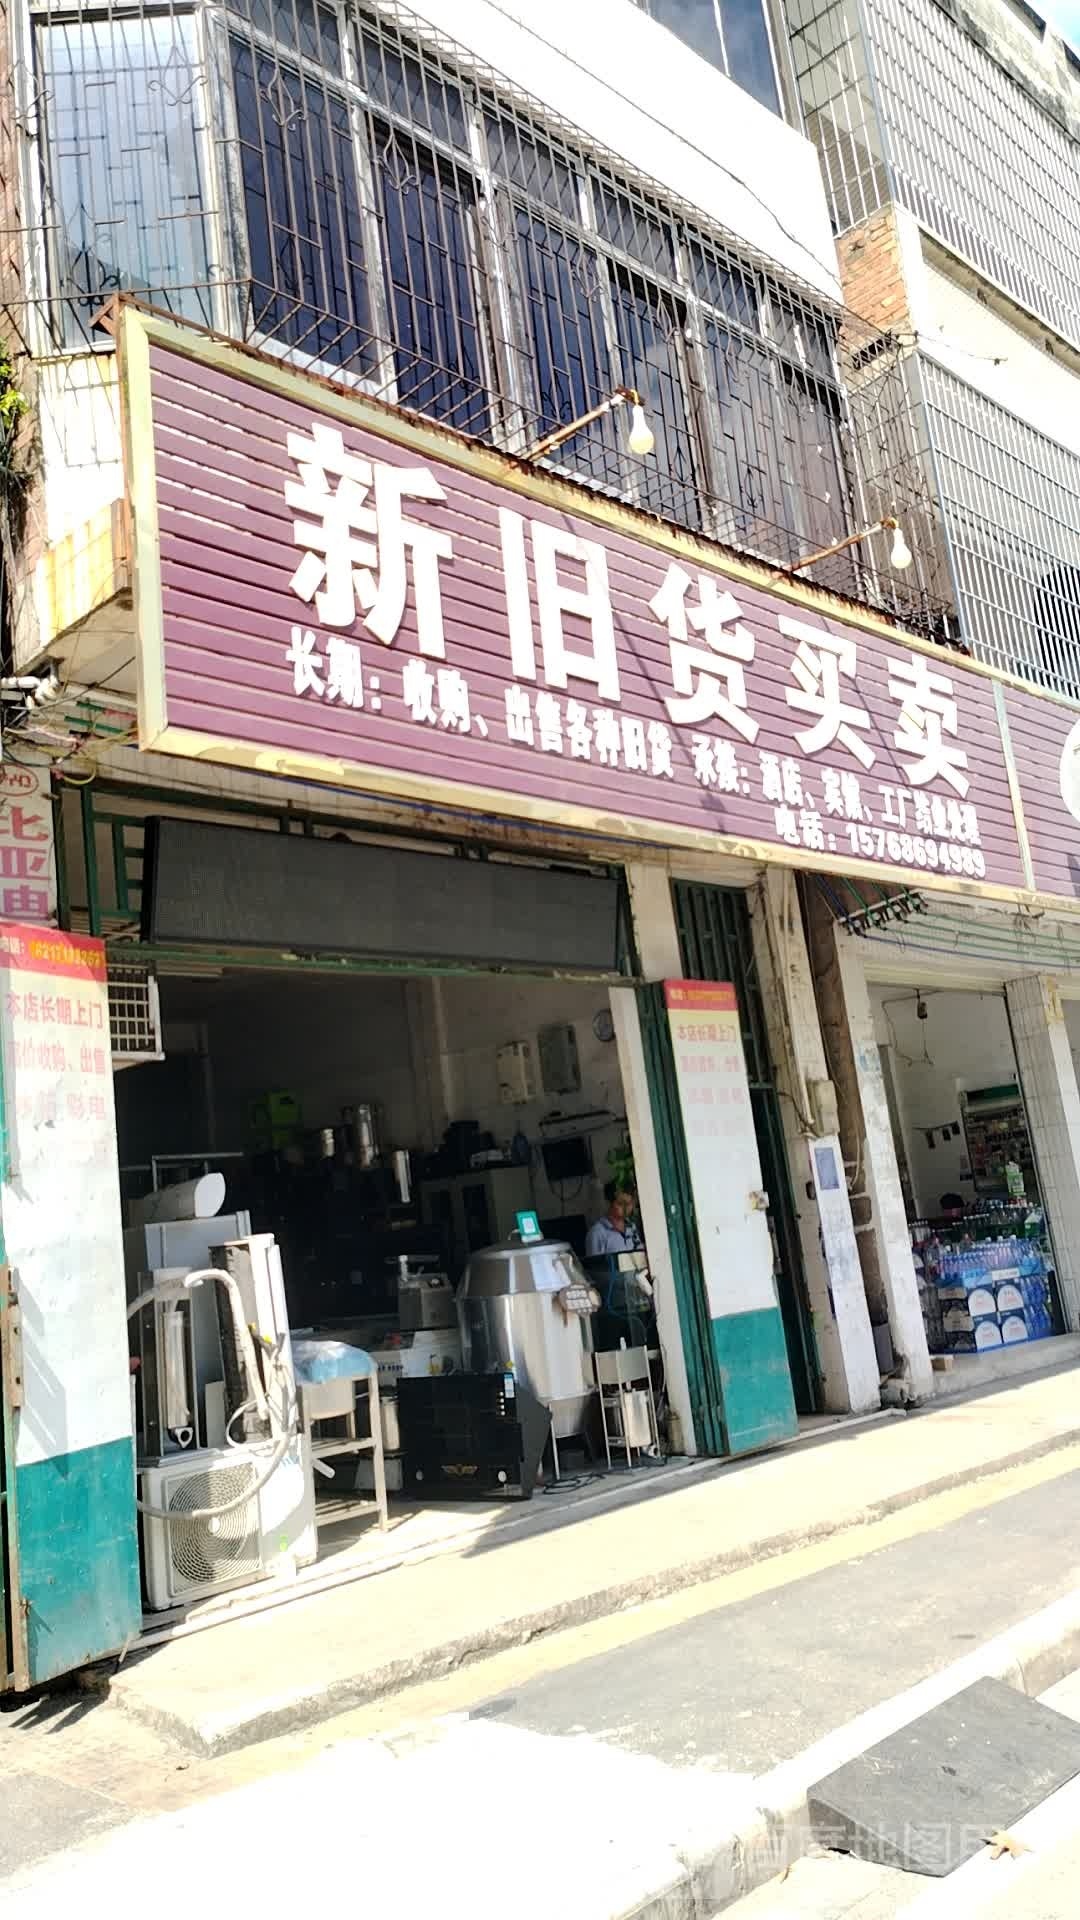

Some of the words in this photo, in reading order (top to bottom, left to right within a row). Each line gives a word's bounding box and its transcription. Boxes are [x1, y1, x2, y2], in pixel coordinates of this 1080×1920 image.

[285, 423, 970, 798] 新旧货买卖
